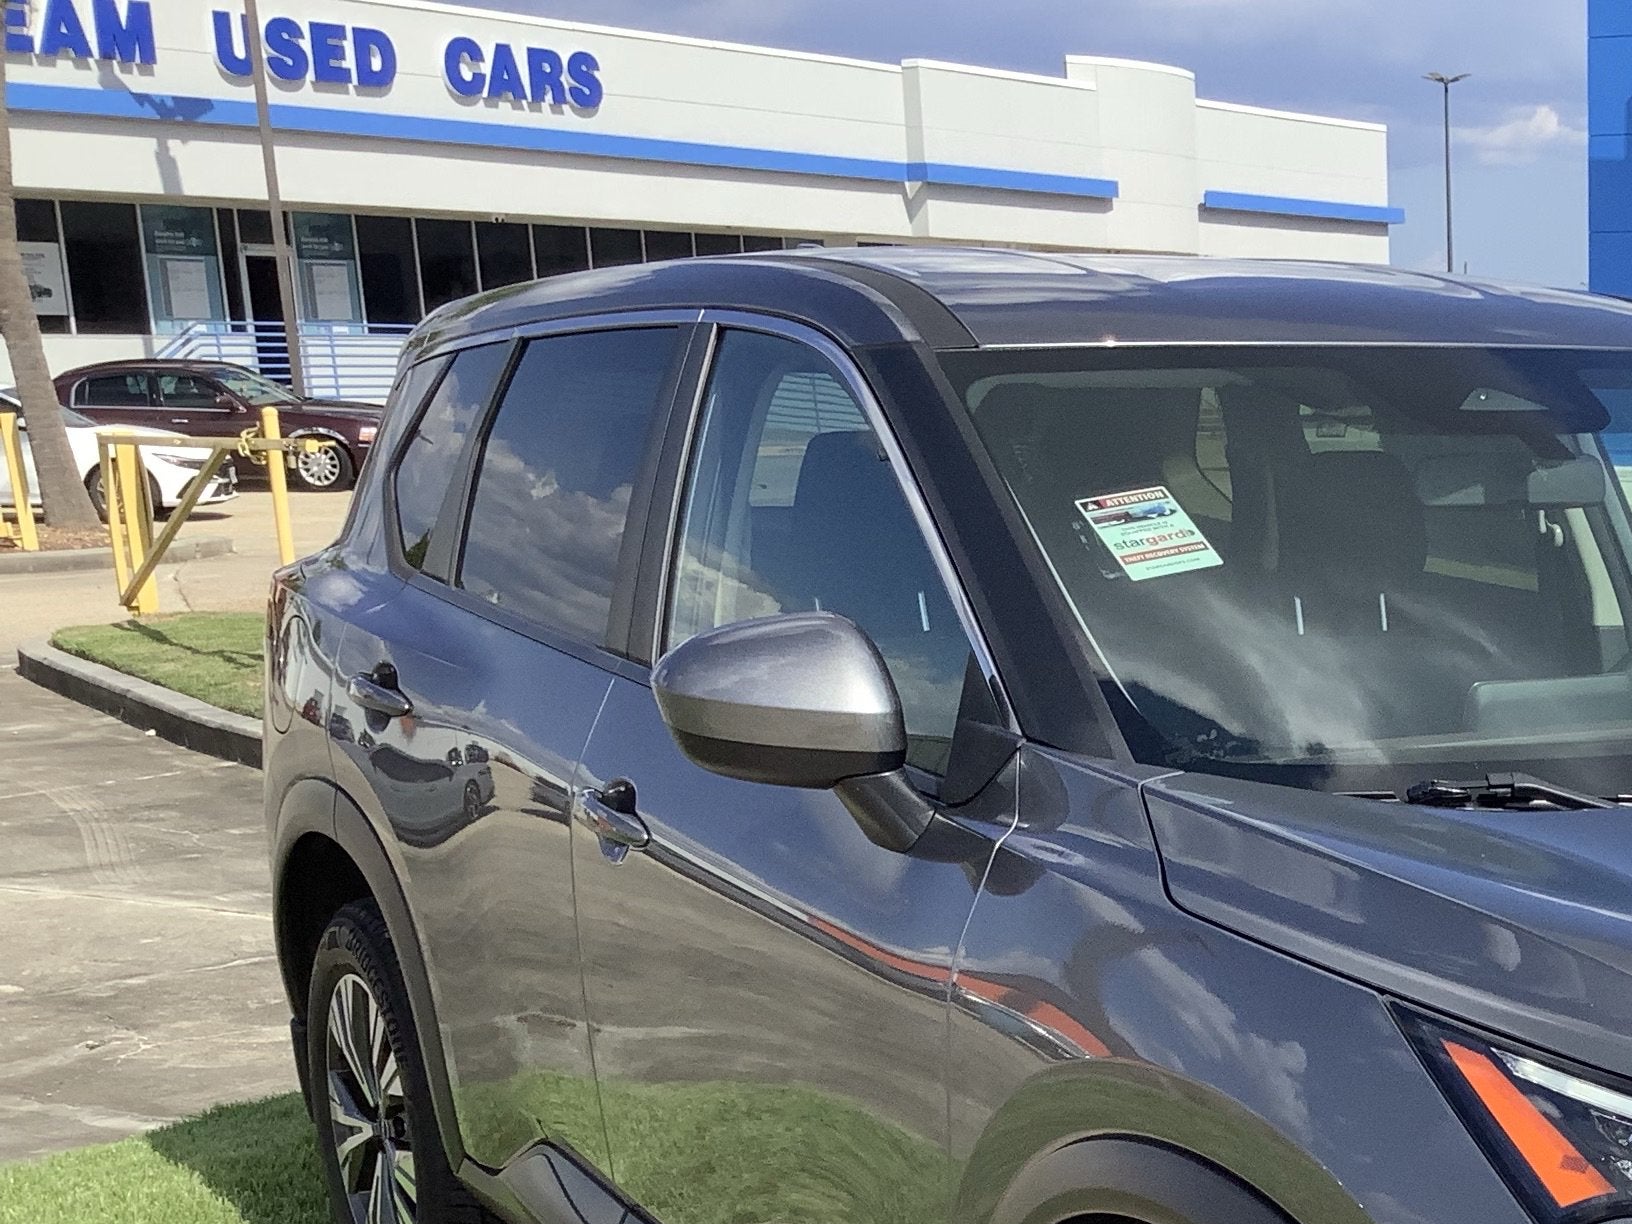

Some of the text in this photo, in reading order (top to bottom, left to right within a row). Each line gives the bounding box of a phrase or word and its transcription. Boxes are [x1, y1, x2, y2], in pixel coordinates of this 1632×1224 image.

[212, 10, 398, 87] USED
[444, 37, 603, 109] CARS
[1104, 490, 1165, 507] ATTENTION
